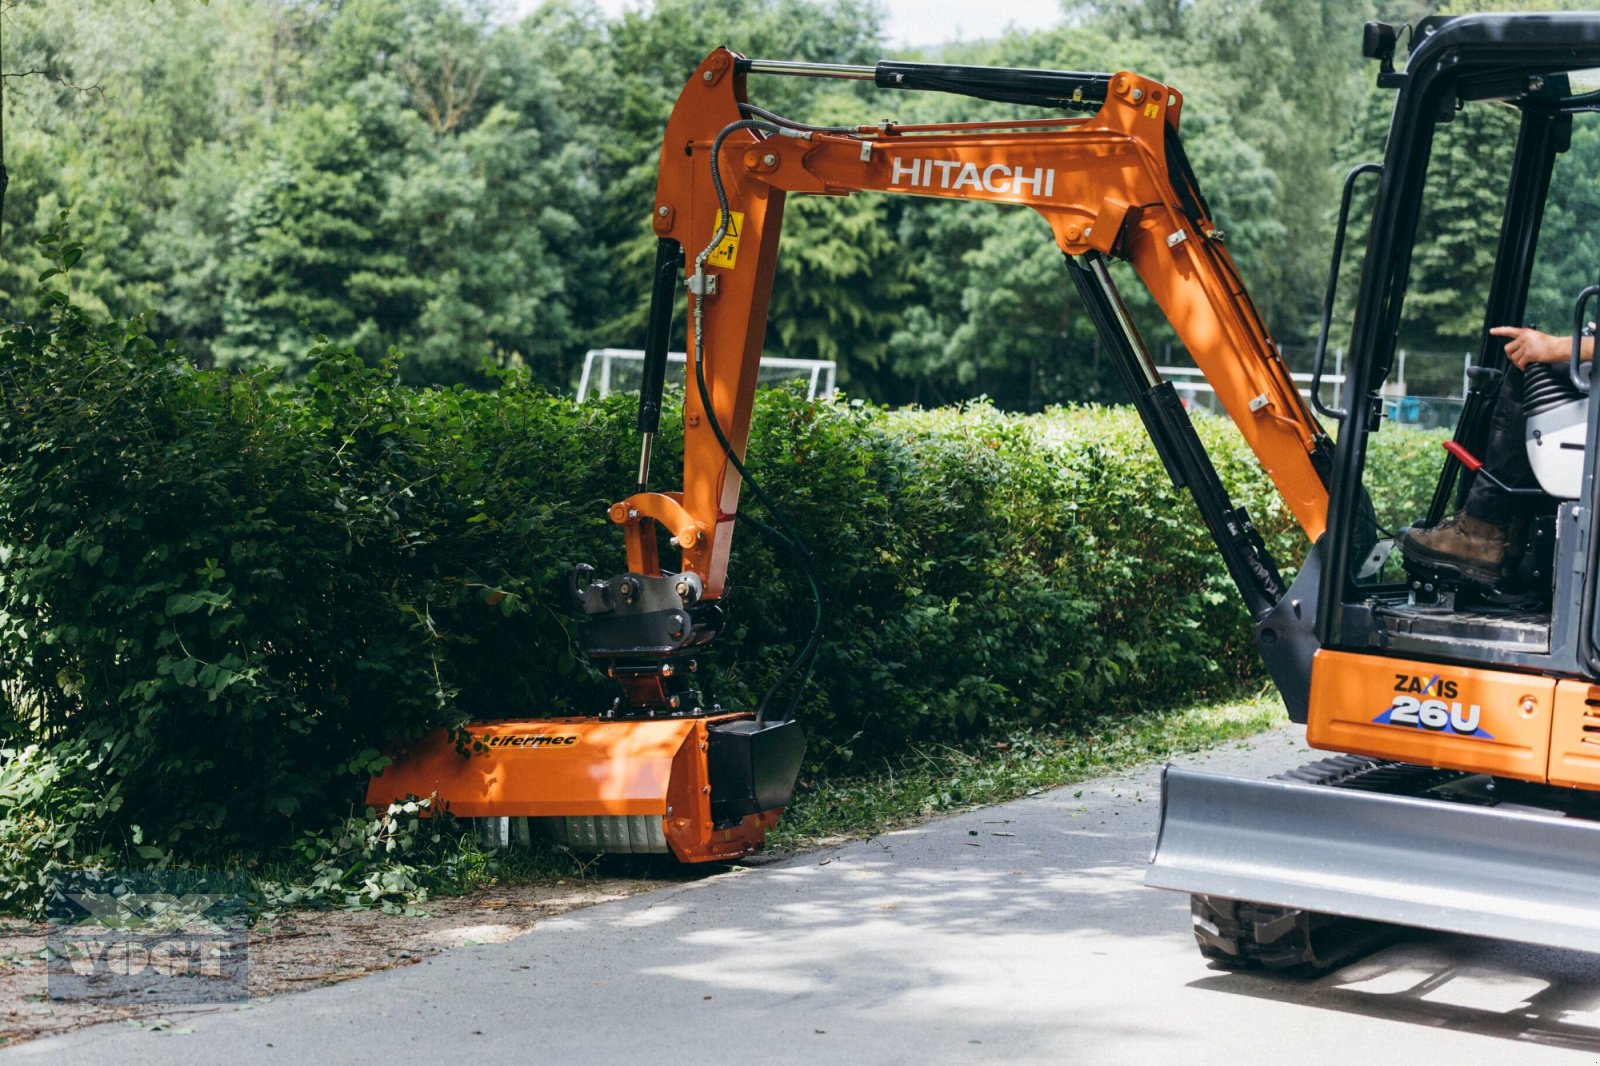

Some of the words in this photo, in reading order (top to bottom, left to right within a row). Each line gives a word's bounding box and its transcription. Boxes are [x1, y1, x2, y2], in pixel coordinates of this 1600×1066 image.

[891, 156, 1055, 197] HITACHI
[1393, 674, 1458, 699] ZAXIS
[1389, 695, 1481, 735] 26U
[489, 735, 577, 747] tifermec
